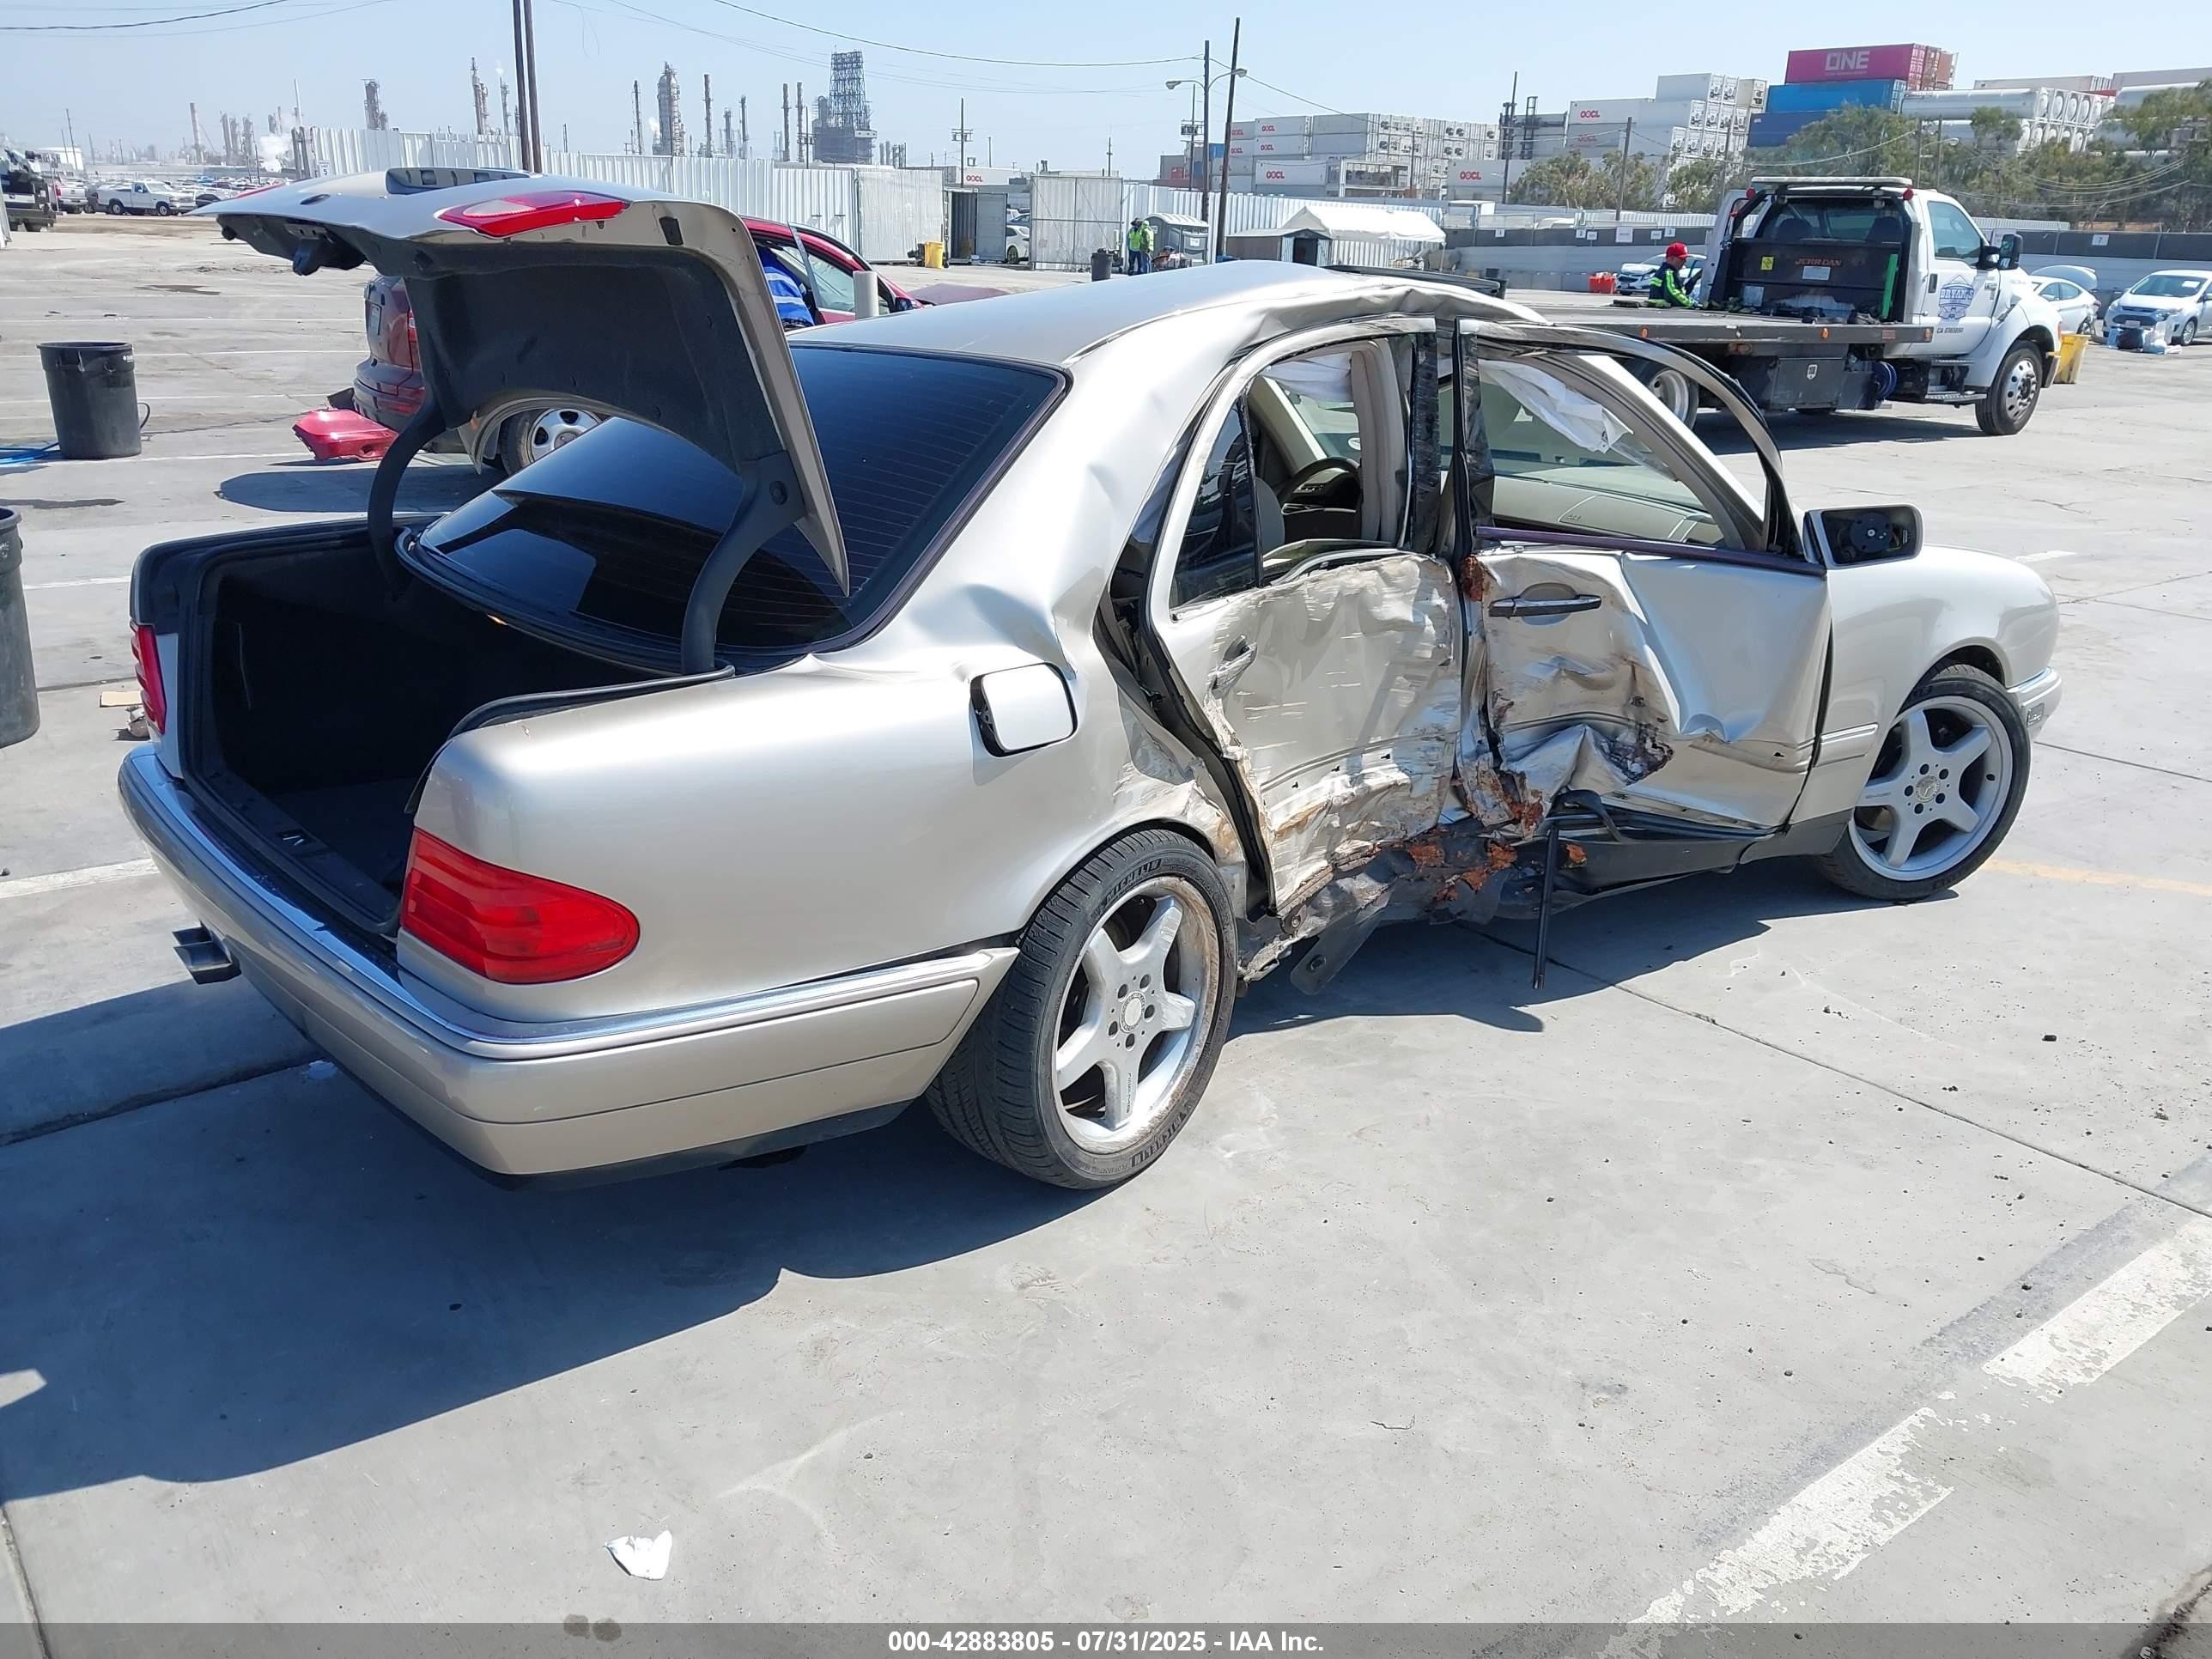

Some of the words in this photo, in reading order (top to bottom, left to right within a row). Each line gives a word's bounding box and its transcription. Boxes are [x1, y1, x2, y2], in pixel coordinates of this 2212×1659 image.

[1826, 51, 1869, 70] ONE
[1580, 110, 1601, 118] OOCL
[1266, 171, 1285, 179] OOCL
[1460, 171, 1482, 180] OOCL
